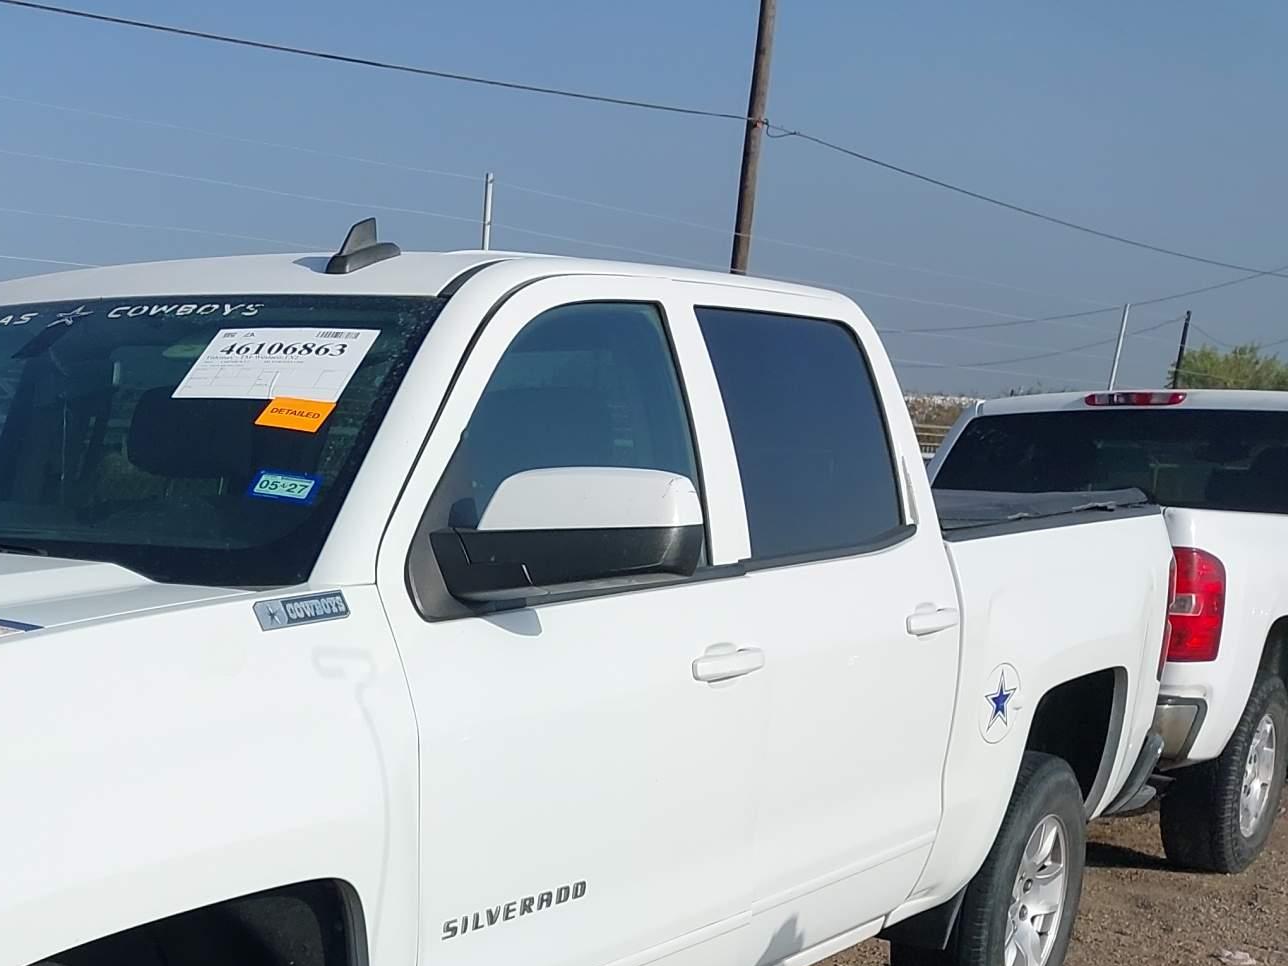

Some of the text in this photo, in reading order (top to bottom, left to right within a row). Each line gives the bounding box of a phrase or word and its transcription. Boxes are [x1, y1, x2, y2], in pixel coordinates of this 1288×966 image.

[106, 303, 265, 319] COWBOYS
[219, 341, 348, 357] 46106863
[270, 407, 321, 420] DETAILED
[285, 595, 347, 621] COWBOYS
[441, 880, 587, 941] SILVERADO
